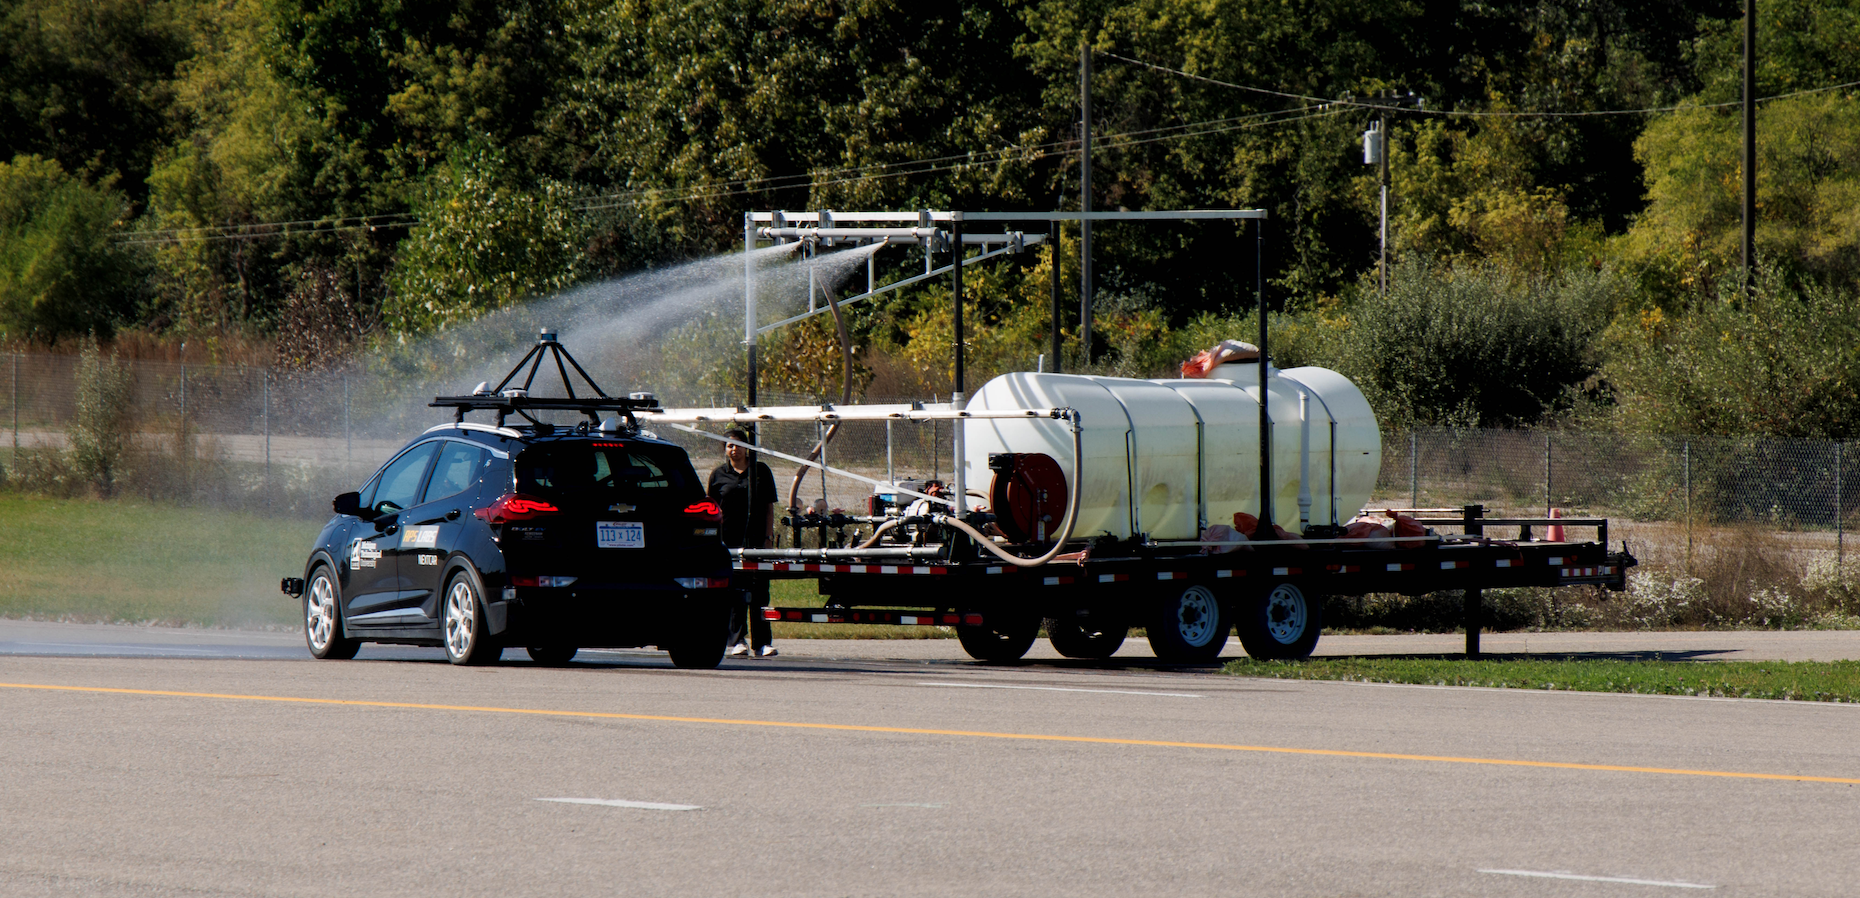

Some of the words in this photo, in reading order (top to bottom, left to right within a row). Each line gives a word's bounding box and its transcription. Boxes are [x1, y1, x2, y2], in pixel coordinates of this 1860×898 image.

[403, 529, 419, 543] APS
[416, 530, 438, 543] LABS
[600, 529, 616, 542] 113
[625, 529, 642, 542] 124
